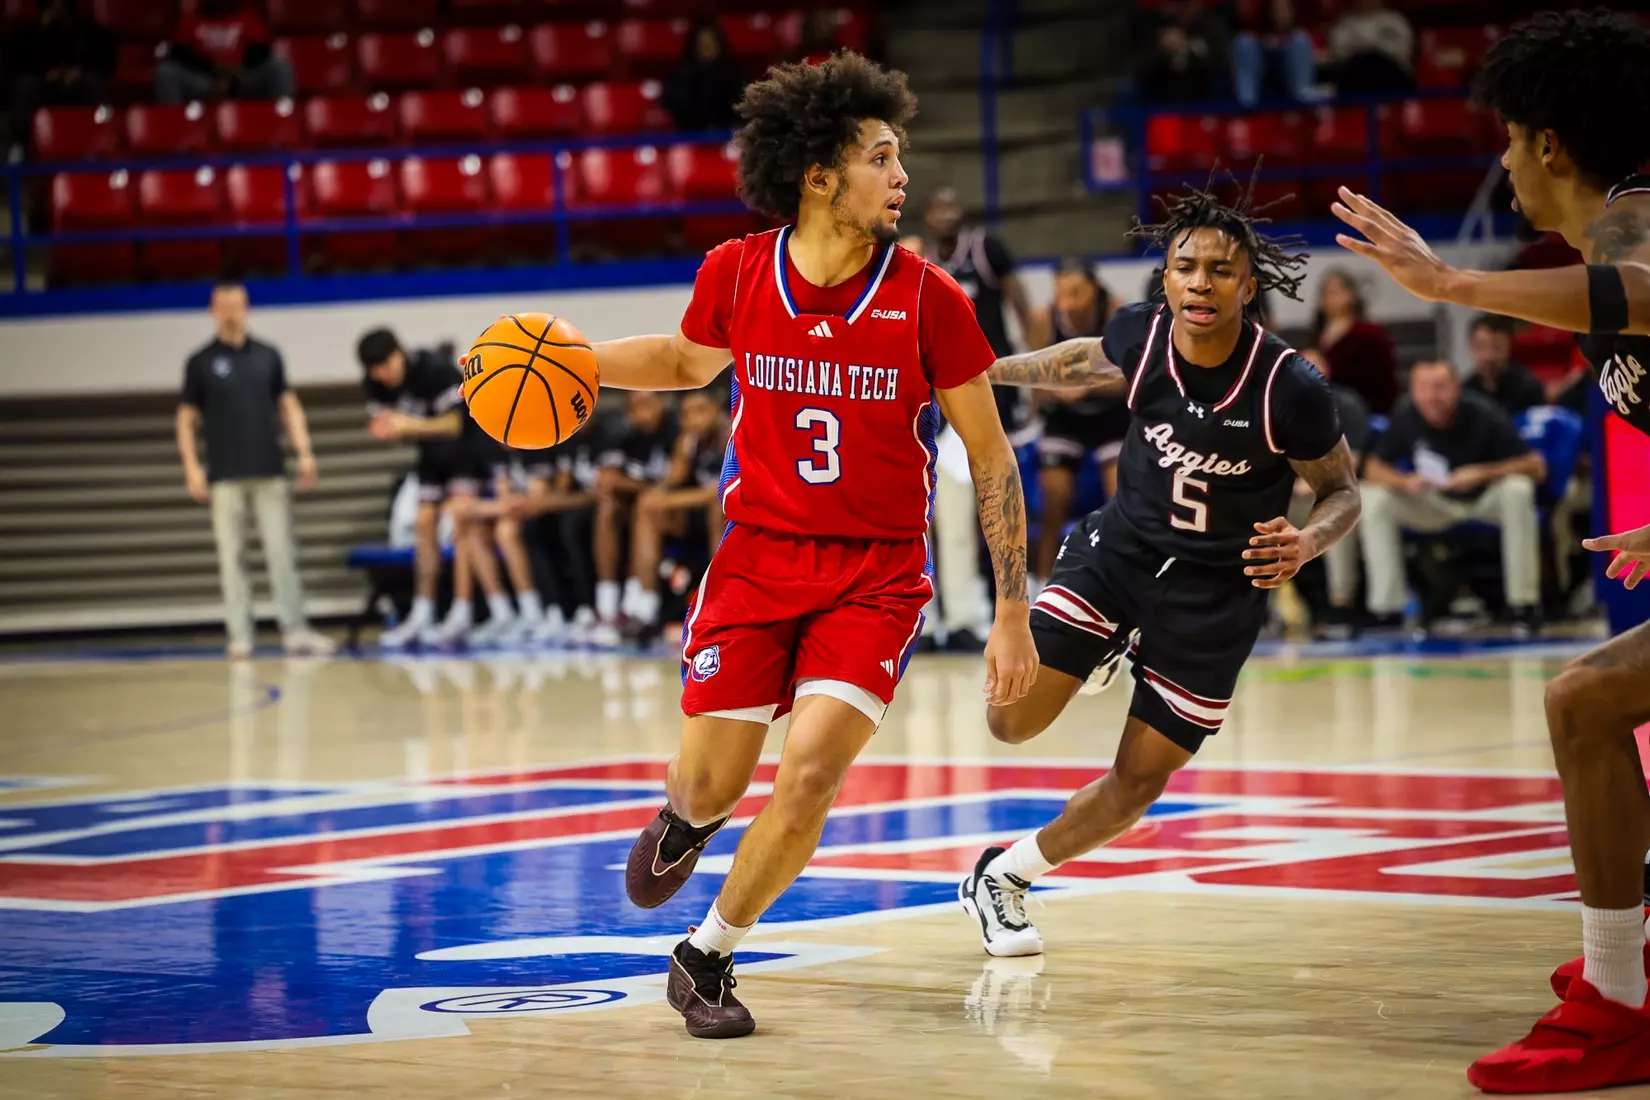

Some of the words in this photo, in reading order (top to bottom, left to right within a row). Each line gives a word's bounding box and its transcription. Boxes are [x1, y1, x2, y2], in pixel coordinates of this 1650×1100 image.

[745, 352, 843, 397] LOUISIANA
[848, 365, 899, 400] TECH
[1599, 353, 1647, 415] Aggie
[795, 406, 841, 485] 3
[1144, 423, 1251, 477] Aggies
[1170, 471, 1209, 532] 5
